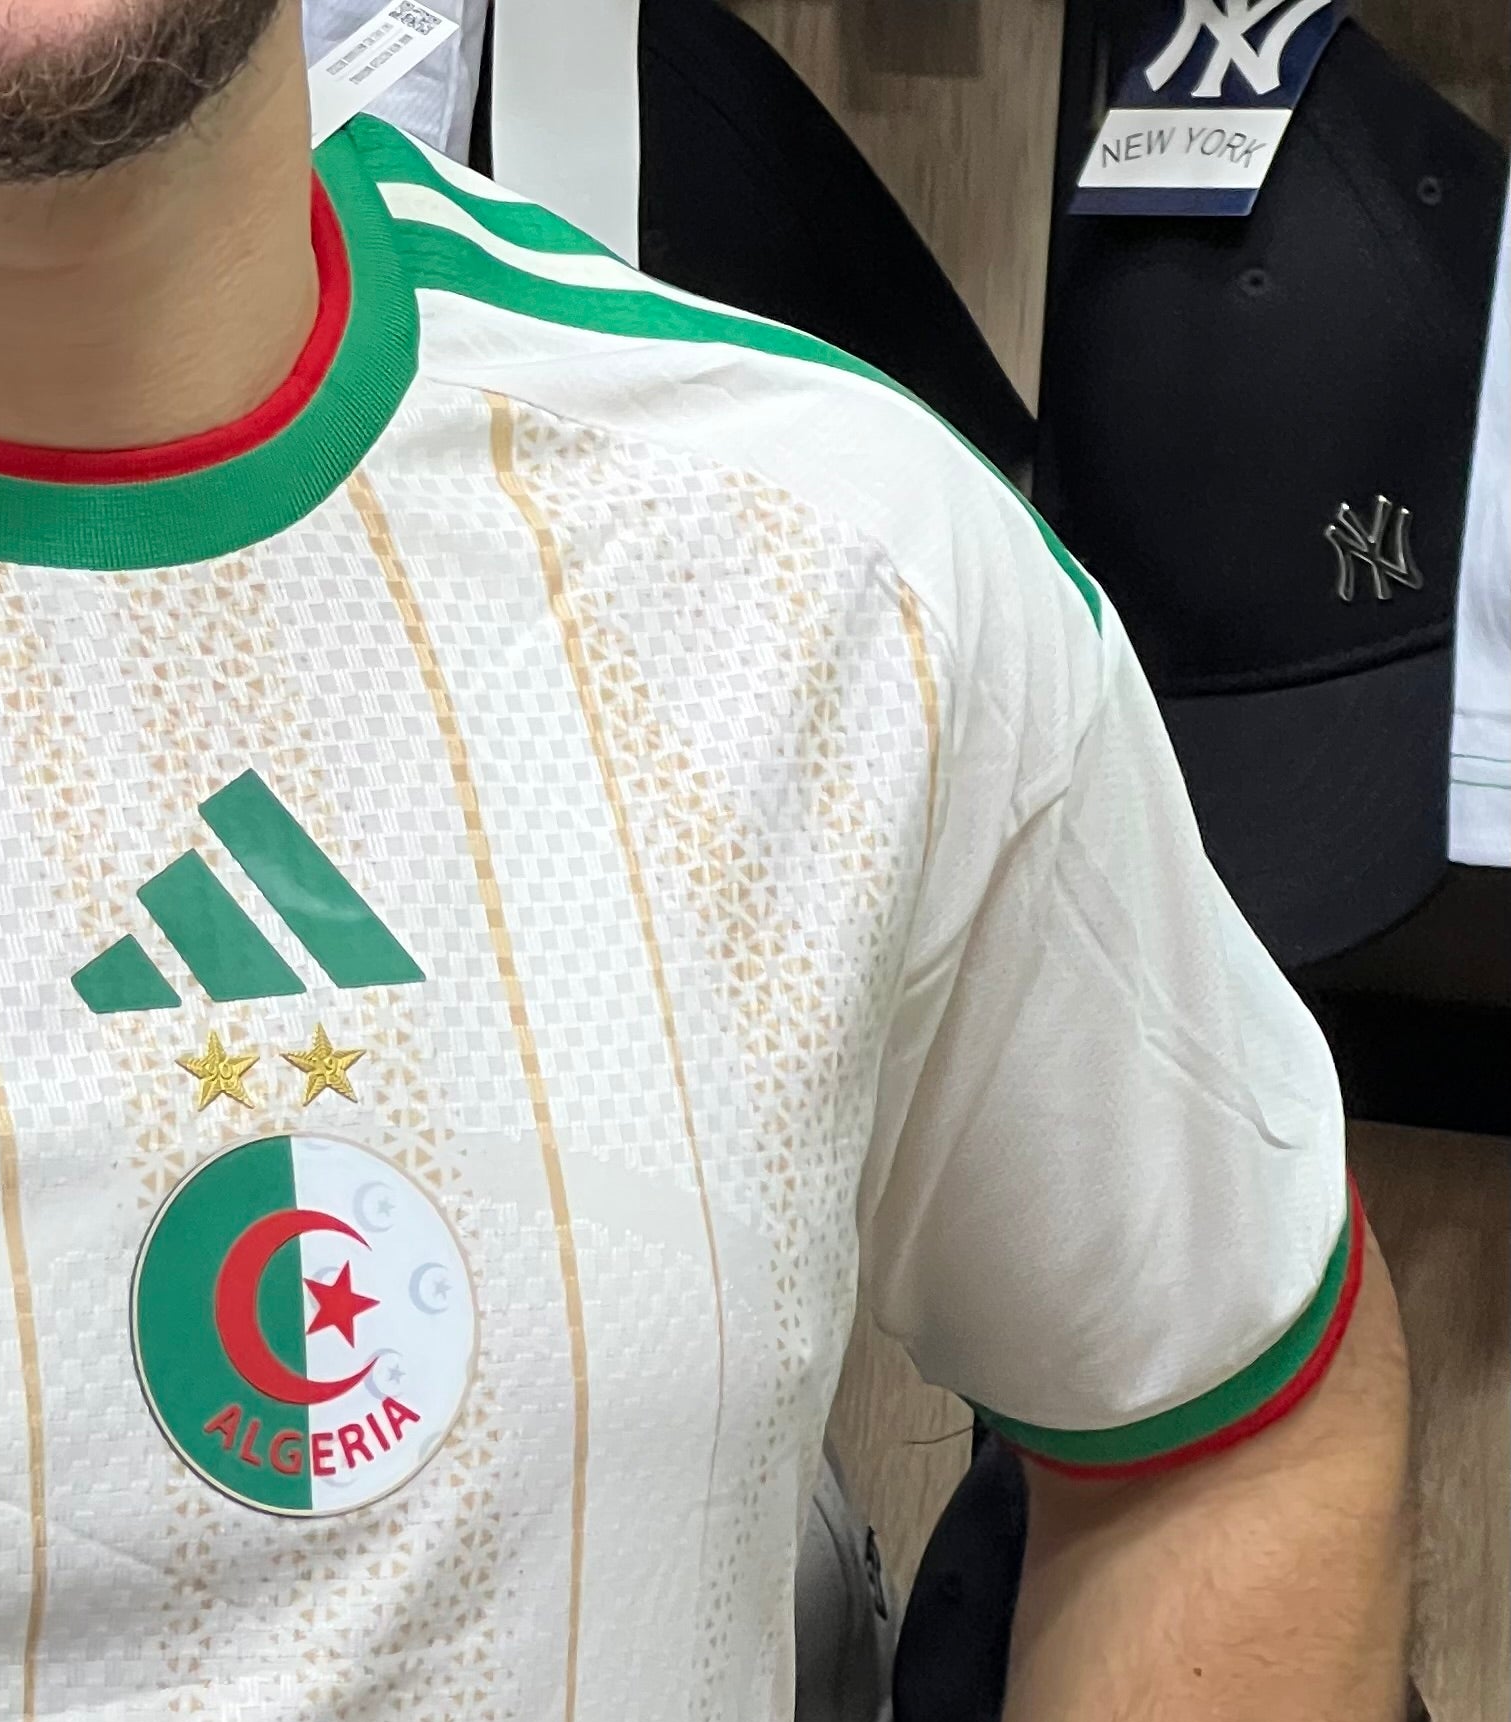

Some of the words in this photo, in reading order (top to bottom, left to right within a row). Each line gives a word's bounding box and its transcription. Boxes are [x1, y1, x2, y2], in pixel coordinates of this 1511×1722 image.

[1101, 126, 1176, 168] NEW
[1184, 127, 1267, 168] YORK
[203, 1396, 422, 1477] ALGERIA
